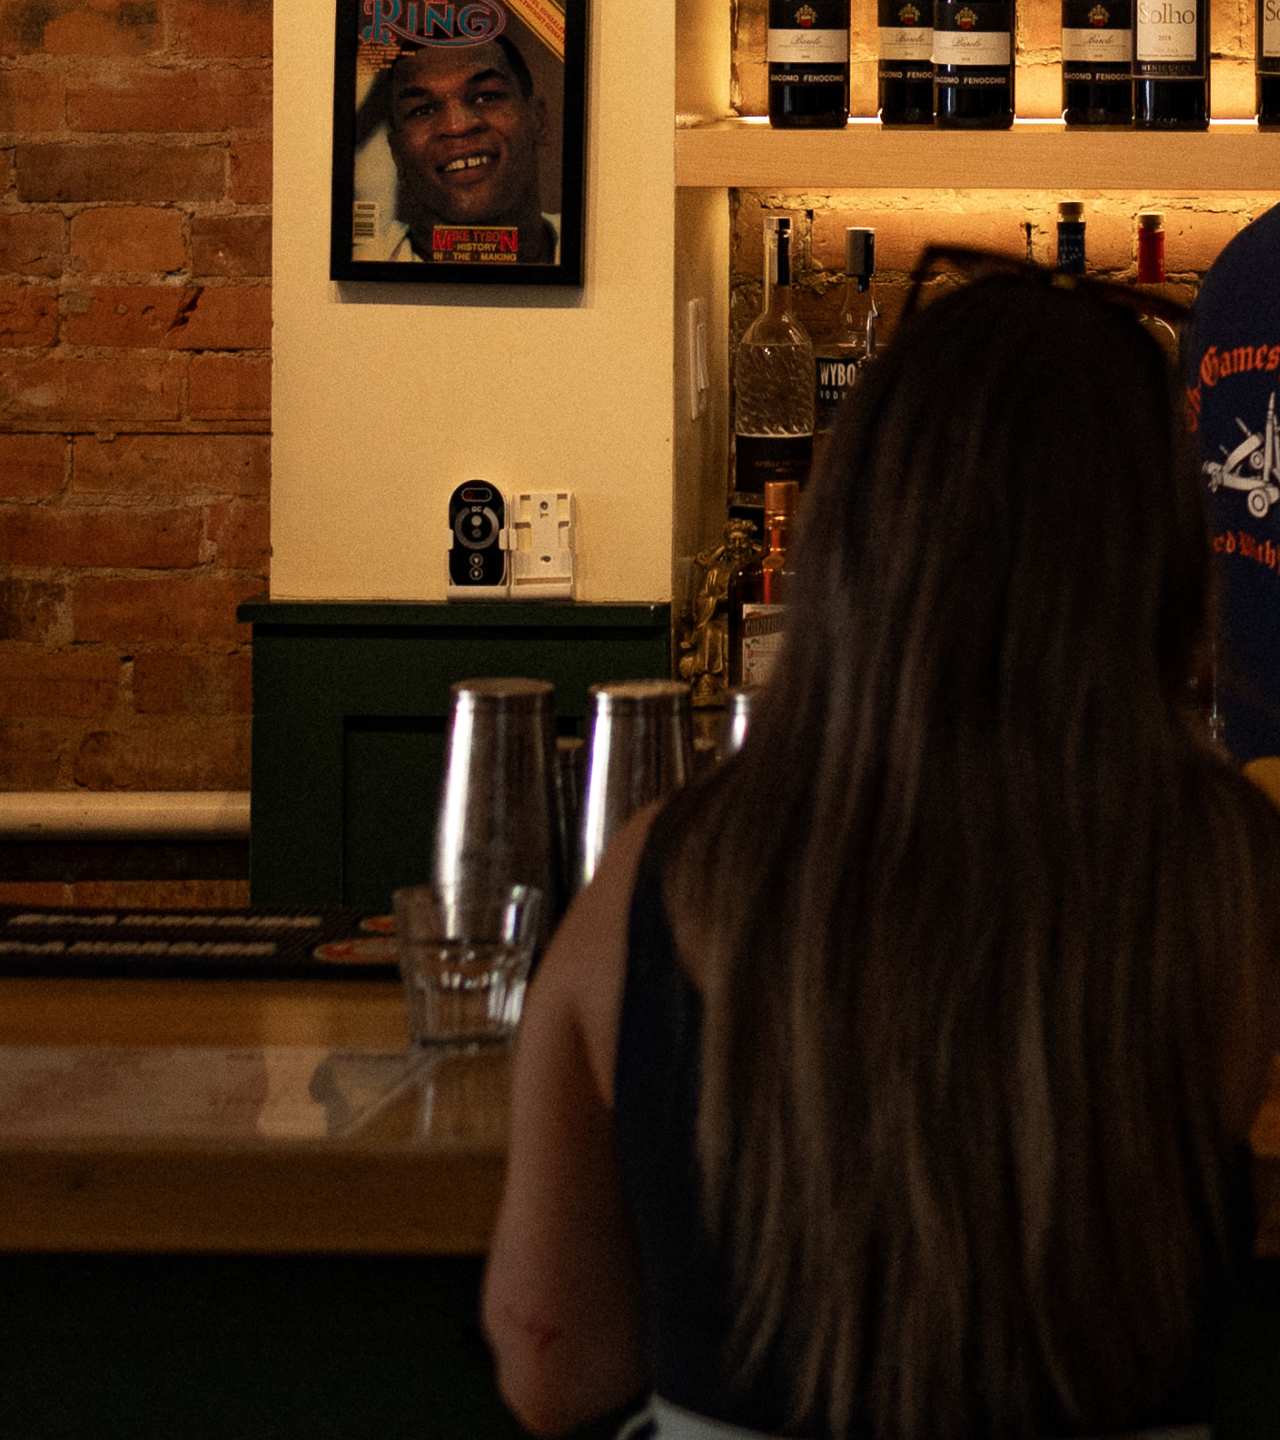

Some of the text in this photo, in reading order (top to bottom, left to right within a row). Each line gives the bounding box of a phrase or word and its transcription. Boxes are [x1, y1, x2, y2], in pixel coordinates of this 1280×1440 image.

[1140, 2, 1195, 25] Solho
[457, 242, 496, 251] HISTORY
[452, 252, 471, 261] THE
[480, 252, 518, 261] MAKING
[820, 362, 856, 386] WYBO
